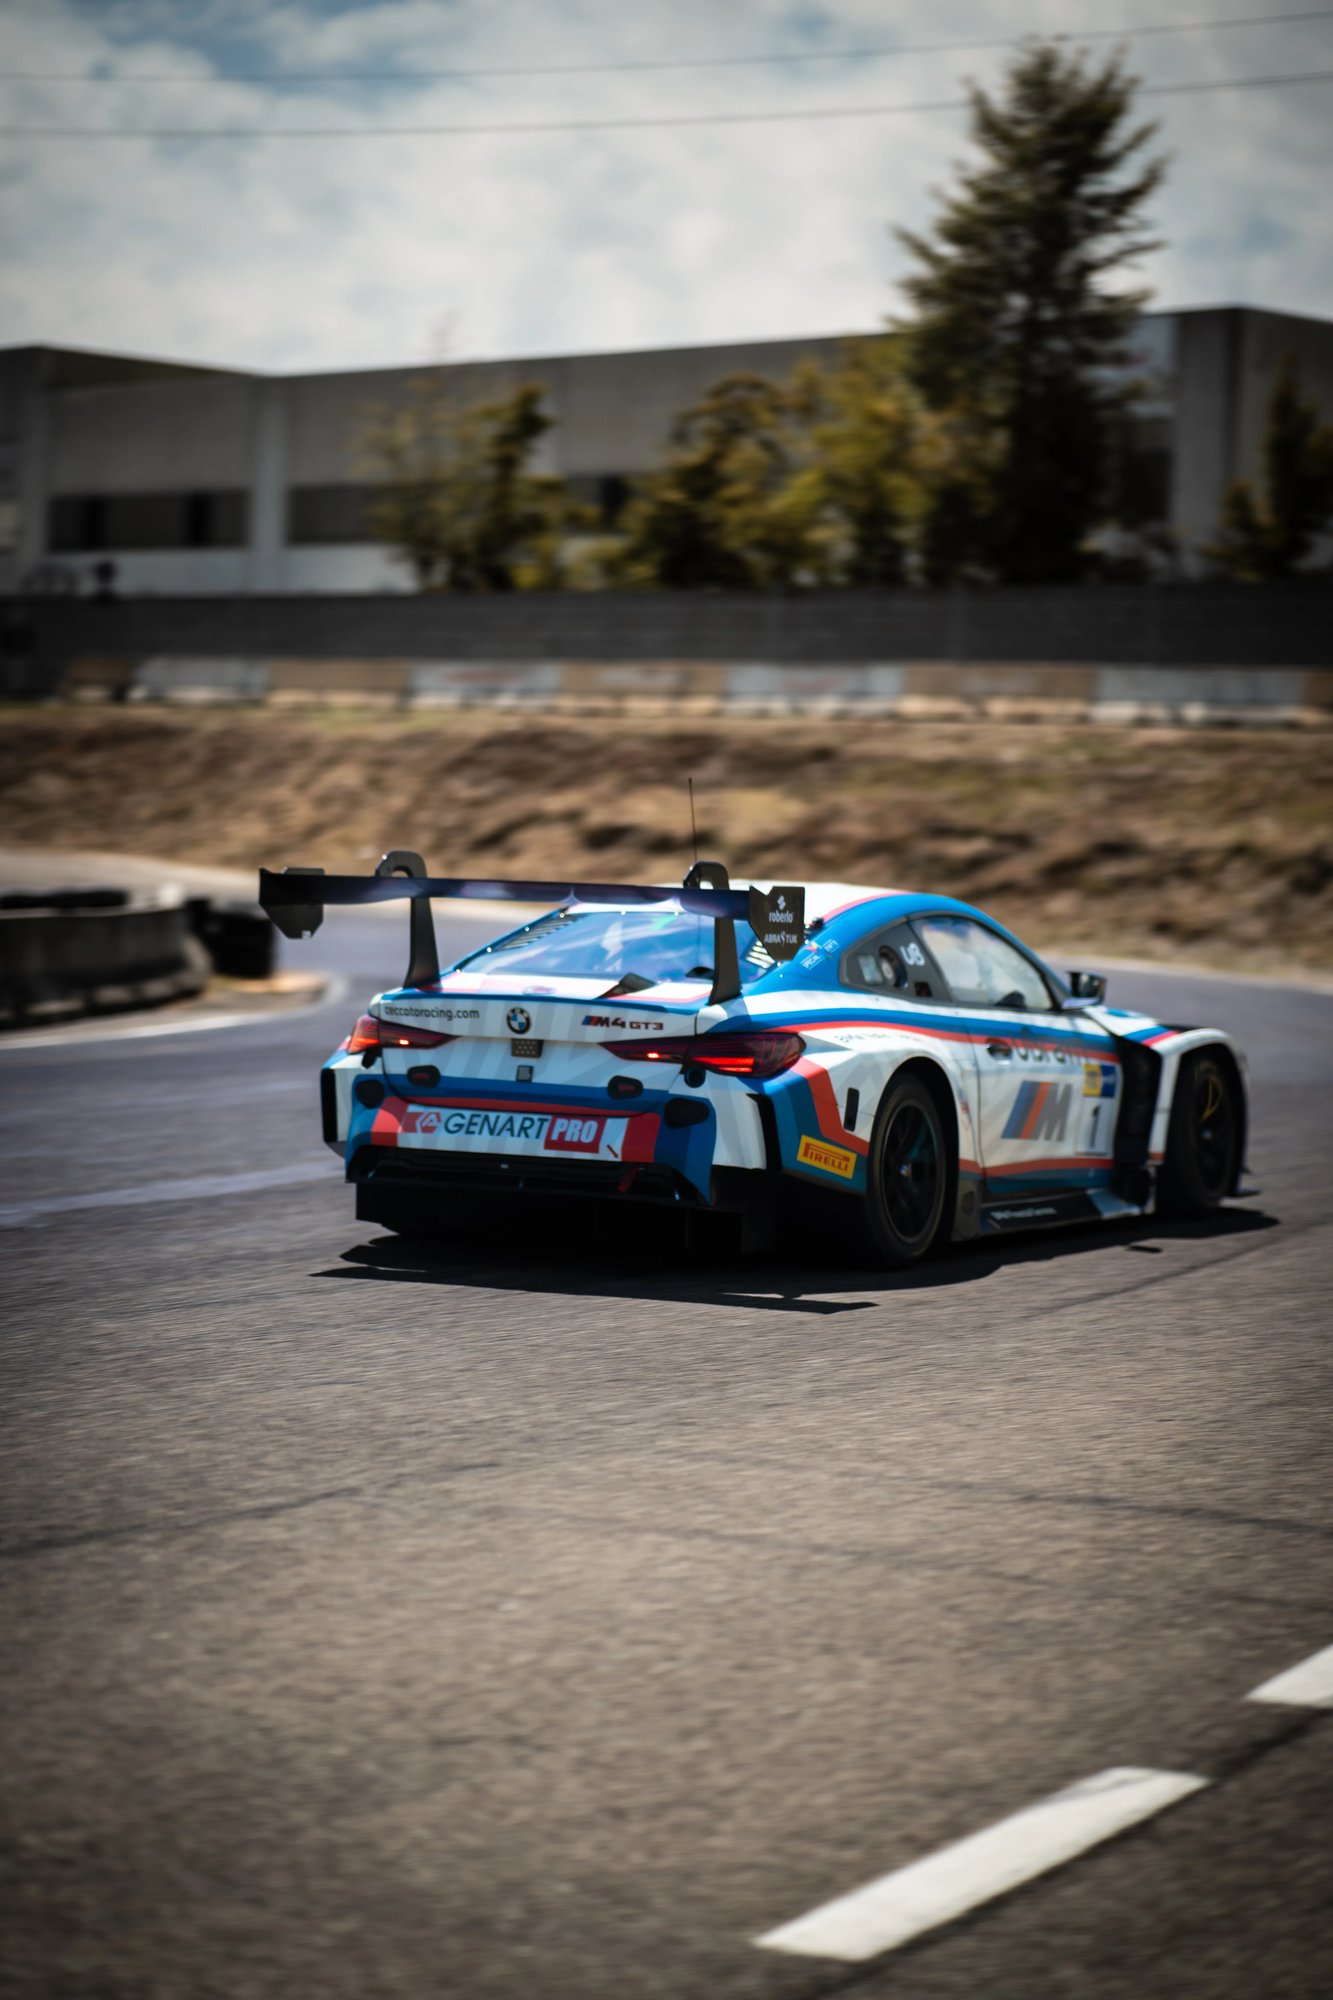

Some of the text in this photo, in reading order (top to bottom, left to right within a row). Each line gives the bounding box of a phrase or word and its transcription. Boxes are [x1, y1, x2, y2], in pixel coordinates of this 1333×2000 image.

[629, 1021, 664, 1031] GT3
[444, 1112, 549, 1140] GENART
[551, 1118, 599, 1144] PRO
[803, 1141, 851, 1171] PIRELLI
